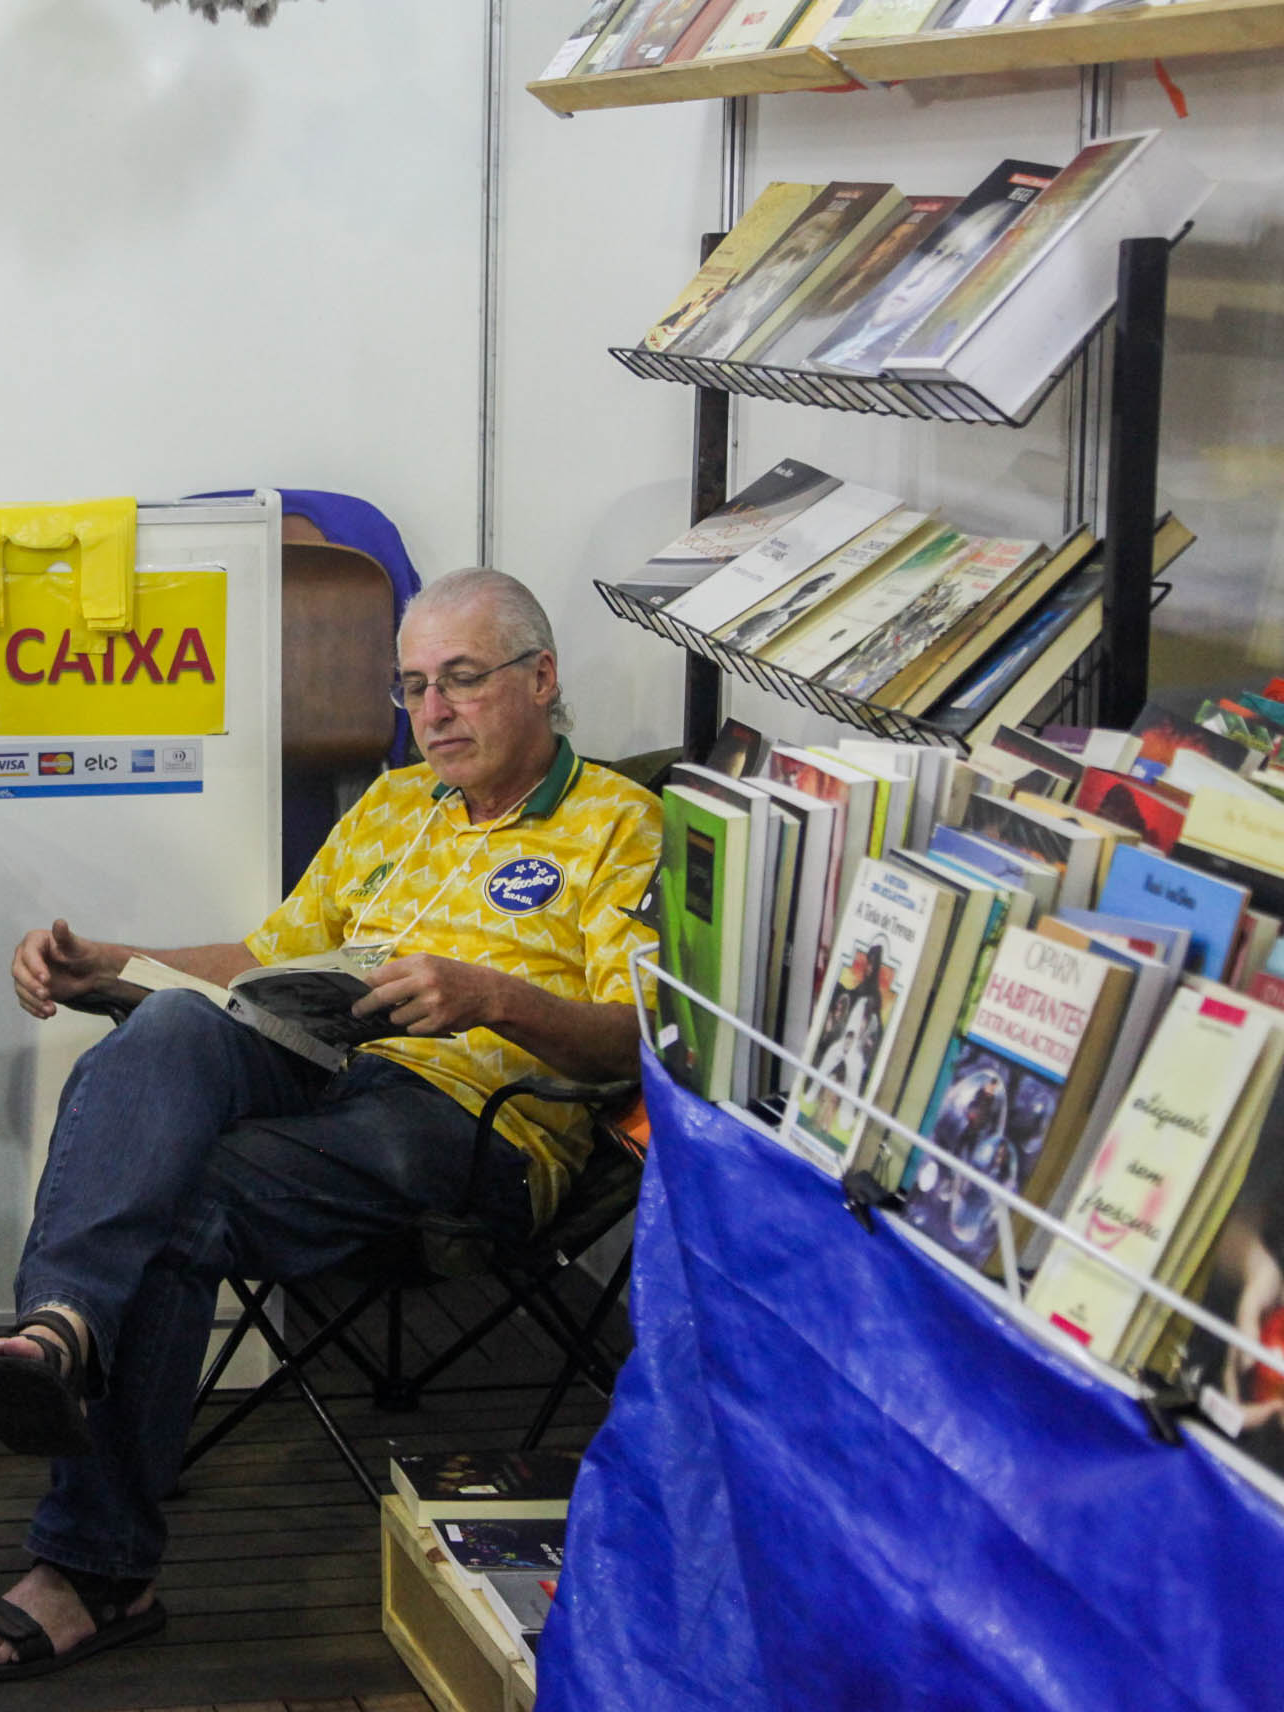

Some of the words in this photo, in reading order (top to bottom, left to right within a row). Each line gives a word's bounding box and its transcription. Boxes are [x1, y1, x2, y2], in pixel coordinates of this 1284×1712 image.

[5, 628, 216, 685] CAIXA
[502, 892, 533, 905] BRASIL
[986, 973, 1087, 1036] HABITANTES
